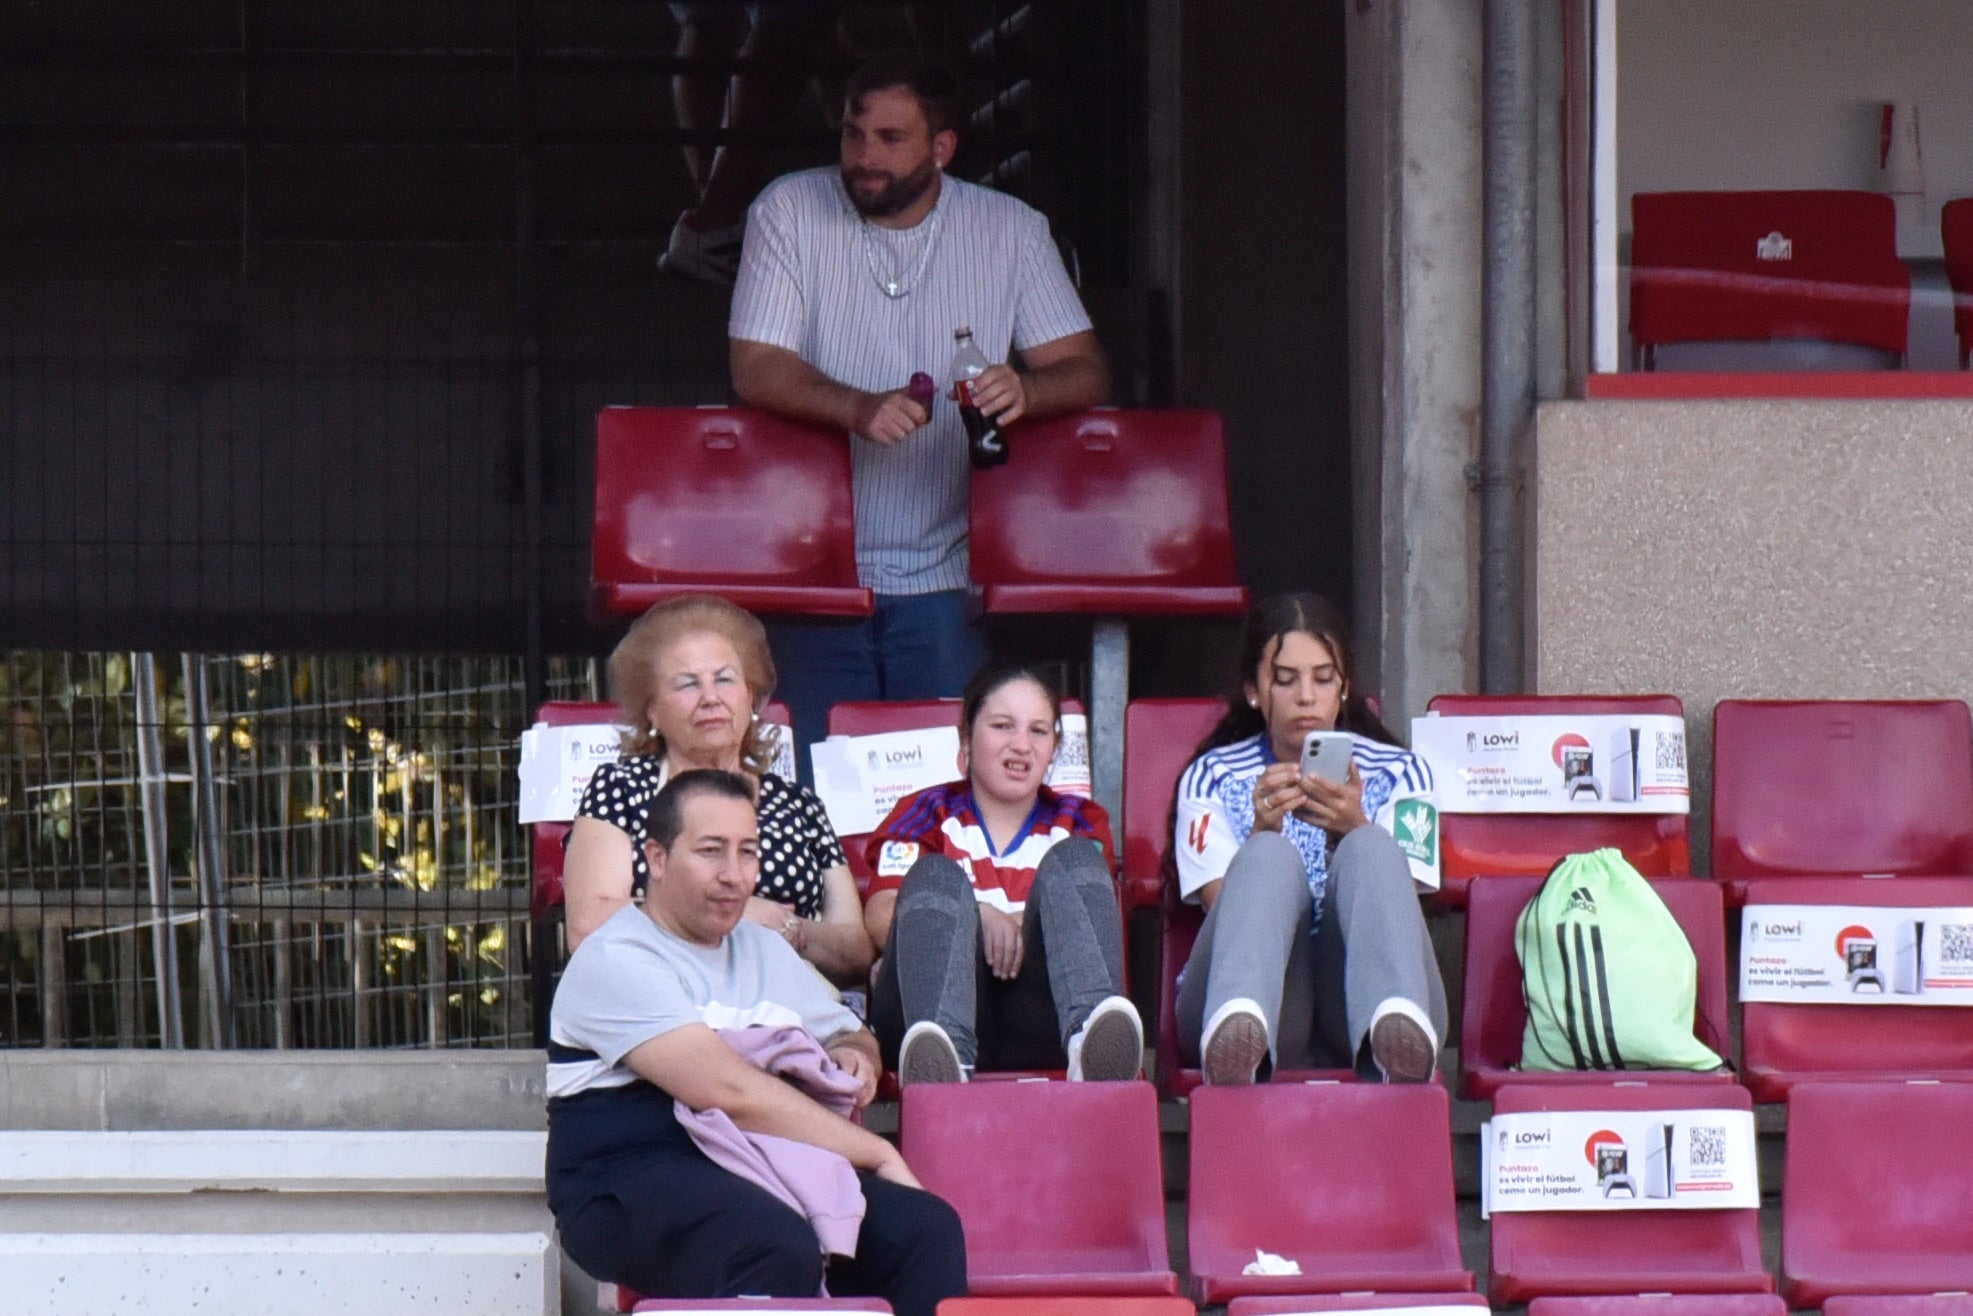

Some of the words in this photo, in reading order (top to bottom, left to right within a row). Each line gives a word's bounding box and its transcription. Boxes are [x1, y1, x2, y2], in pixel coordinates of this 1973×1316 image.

[589, 743, 621, 754] LOW
[873, 784, 913, 793] Puntazo
[1749, 956, 1787, 965] Puntazo
[1499, 1176, 1509, 1184] es
[1511, 1175, 1533, 1183] vivir
[1536, 1174, 1544, 1183] el
